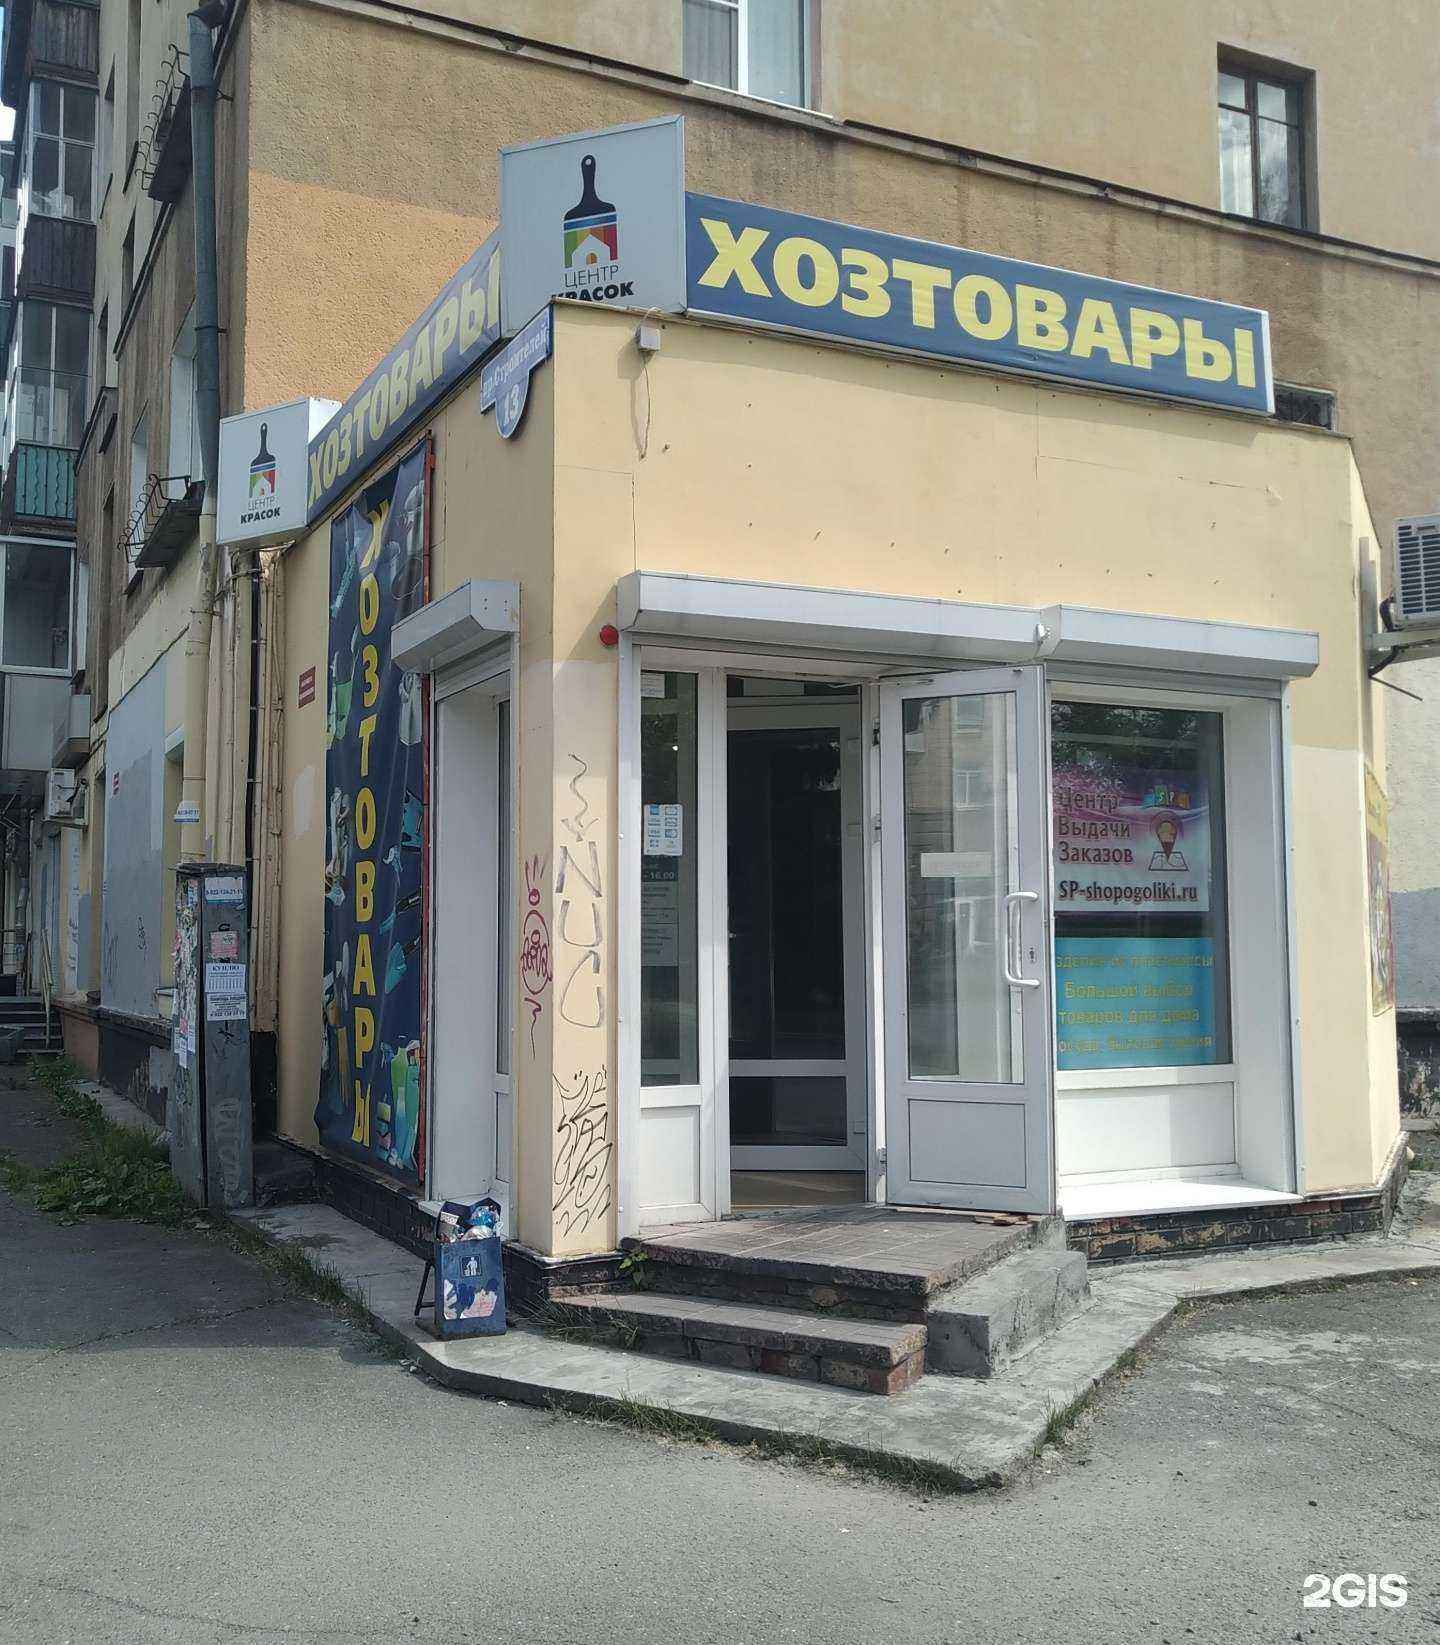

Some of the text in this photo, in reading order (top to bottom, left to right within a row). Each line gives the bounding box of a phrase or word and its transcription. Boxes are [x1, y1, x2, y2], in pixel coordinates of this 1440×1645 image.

[564, 264, 619, 289] ЦЕНТР
[698, 217, 1256, 388] ХОЗТОВАРЫ
[308, 240, 500, 504] ХОЗТОВАРЫ
[248, 496, 275, 511] ЦЕНТР
[240, 507, 281, 525] КРАСОК
[1058, 787, 1119, 814] Центр
[1058, 816, 1131, 840] Выдачи
[1058, 841, 1134, 863] Заказов
[1059, 880, 1198, 904] SP-shopogoliki.ru
